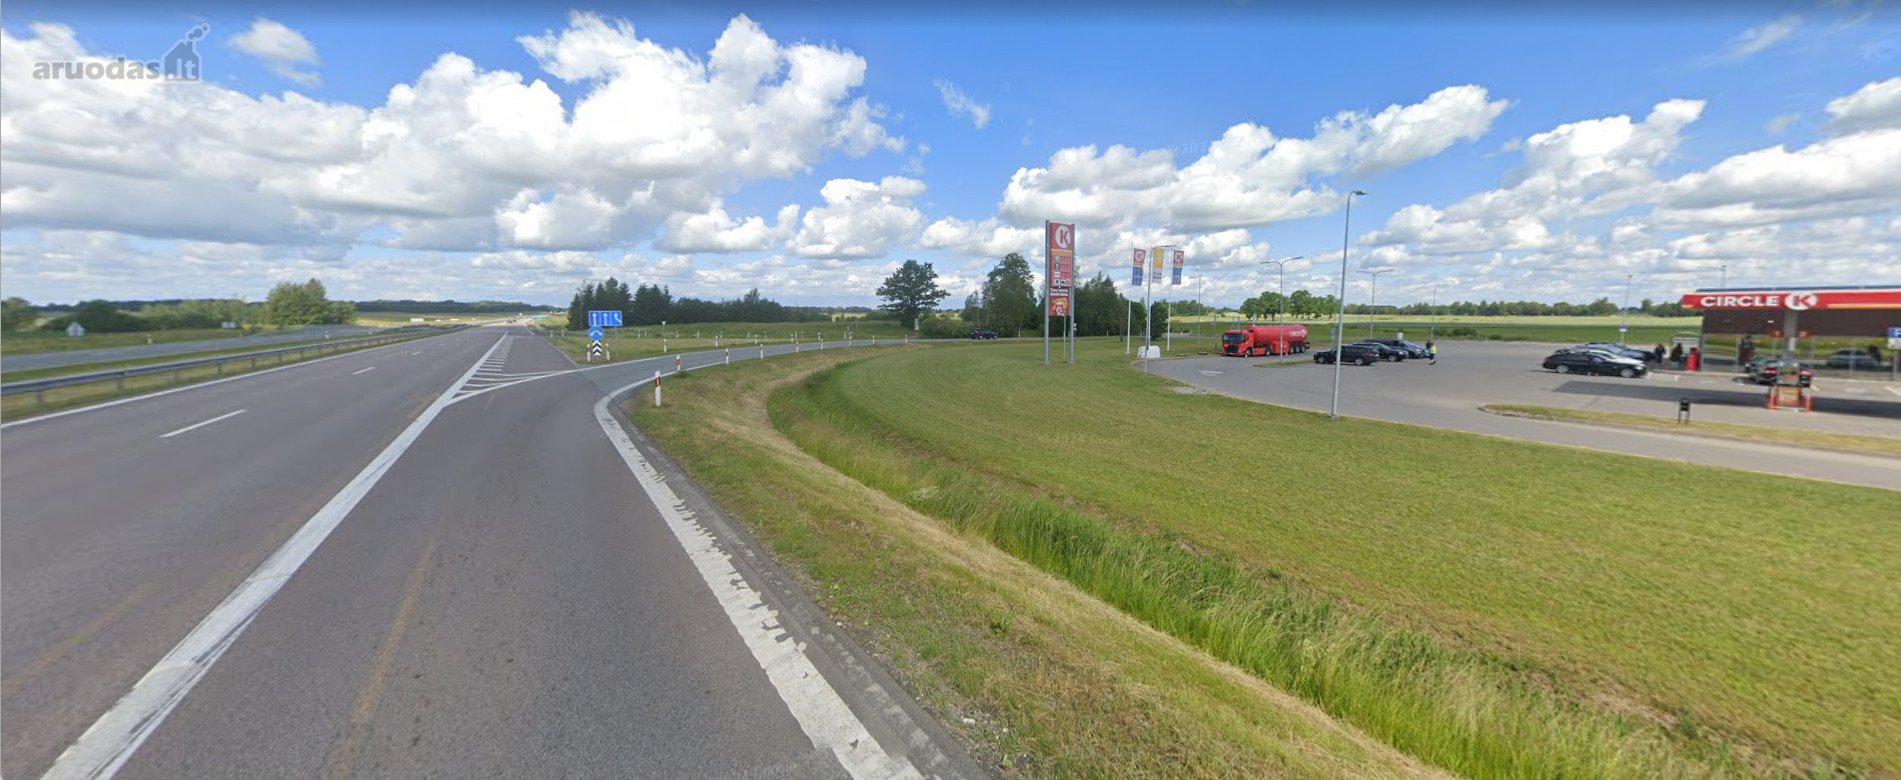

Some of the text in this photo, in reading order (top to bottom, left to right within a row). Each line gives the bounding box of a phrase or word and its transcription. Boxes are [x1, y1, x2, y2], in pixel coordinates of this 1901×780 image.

[1058, 228, 1070, 247] K
[1700, 291, 1815, 309] CIRCLE K
